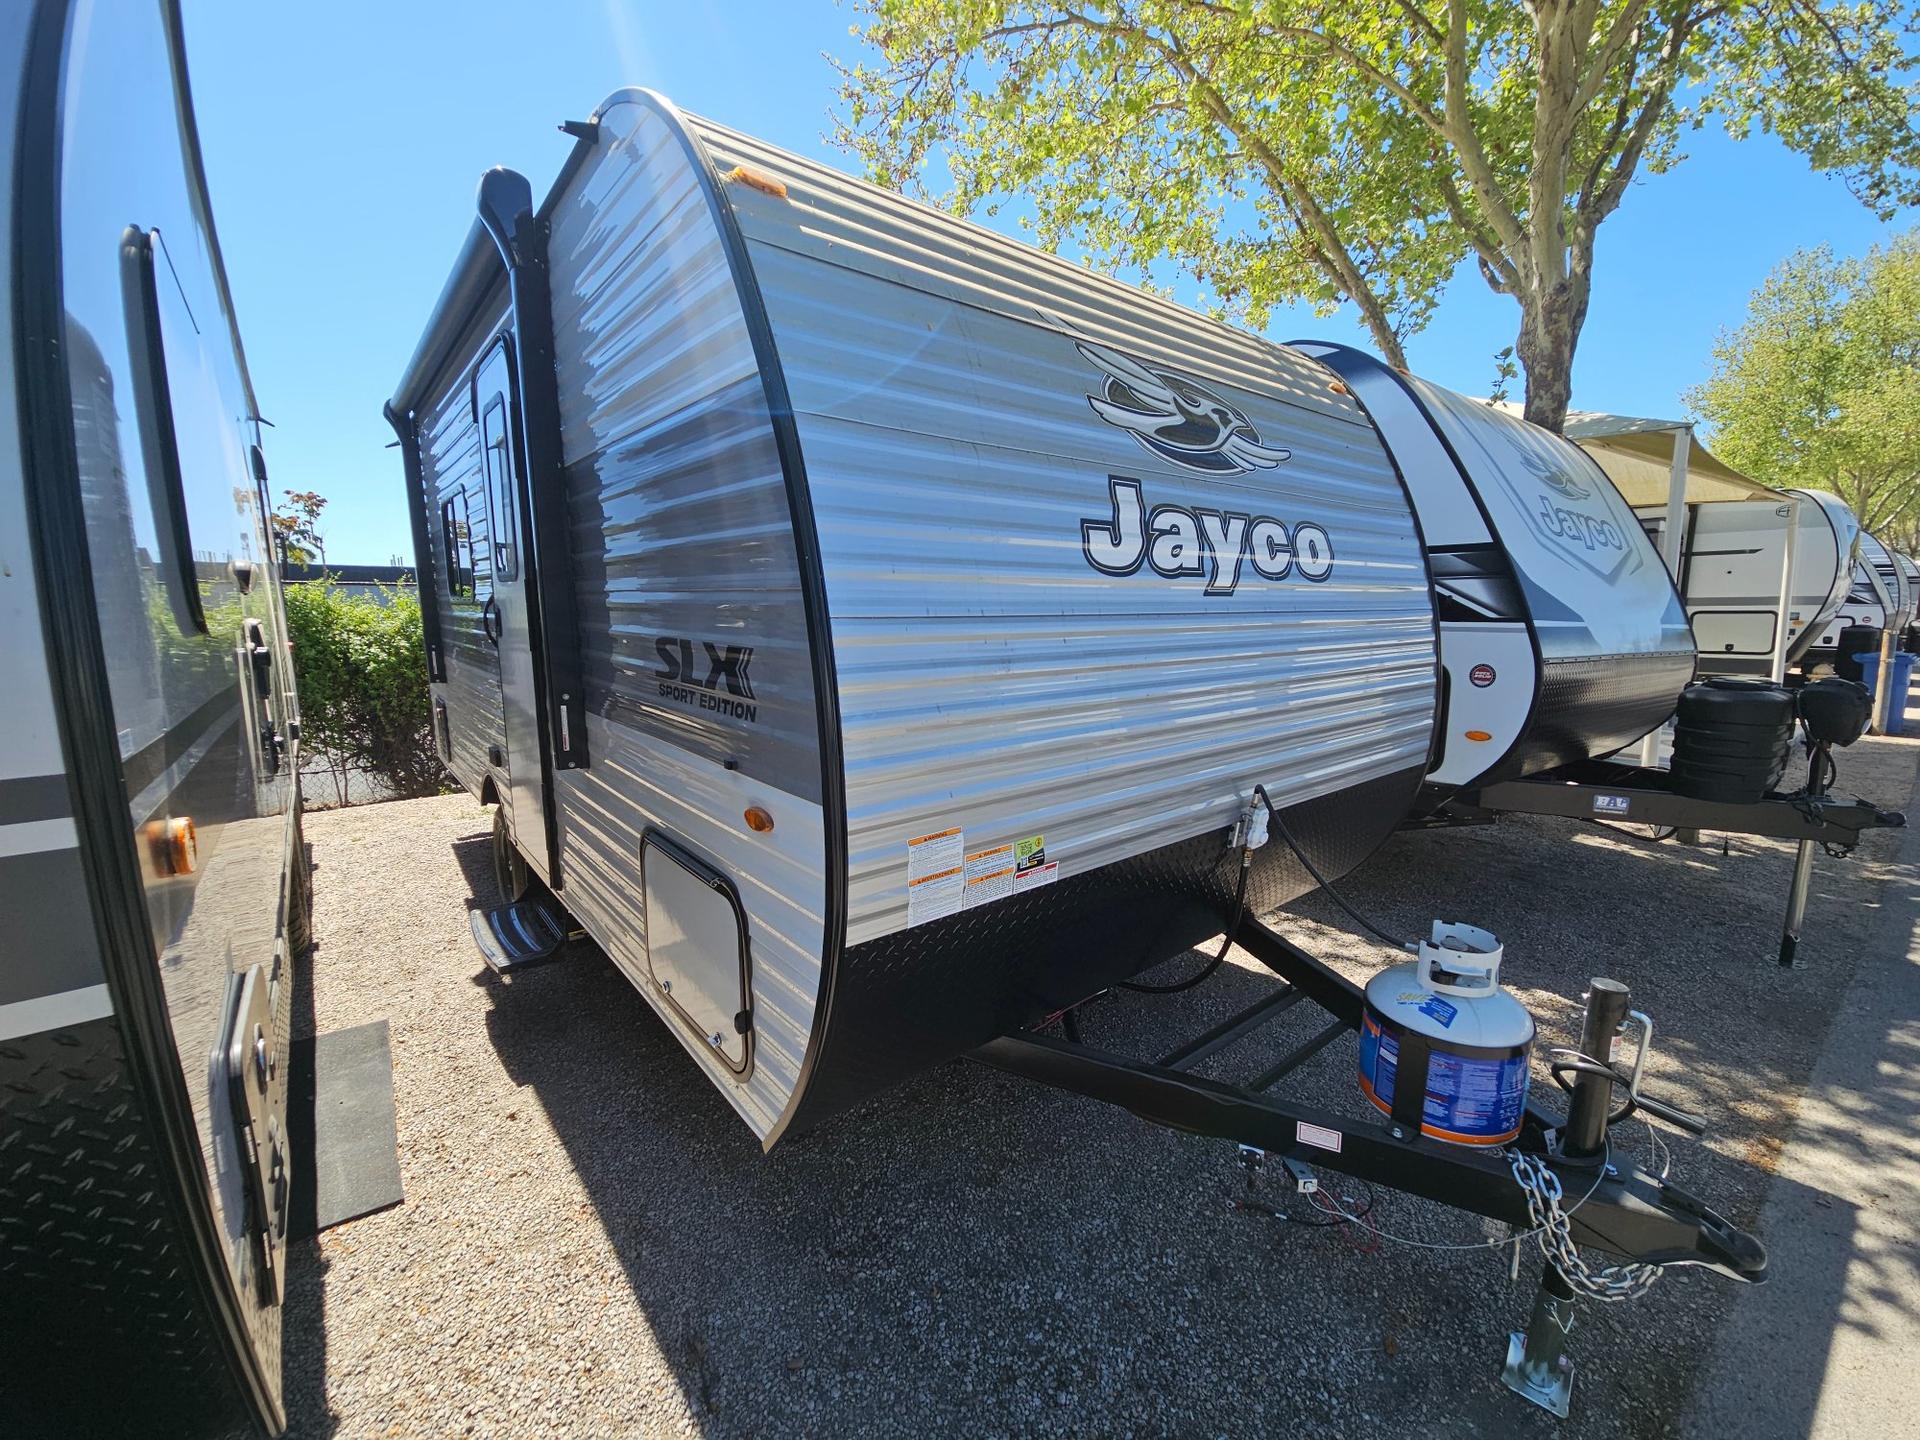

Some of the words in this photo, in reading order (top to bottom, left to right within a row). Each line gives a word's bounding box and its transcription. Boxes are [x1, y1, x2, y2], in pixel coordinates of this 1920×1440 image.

[1080, 474, 1334, 597] Jayco
[1539, 494, 1623, 551] Jayco
[655, 636, 757, 700] SLX
[658, 683, 696, 705] SPORT
[699, 694, 757, 722] EDITION
